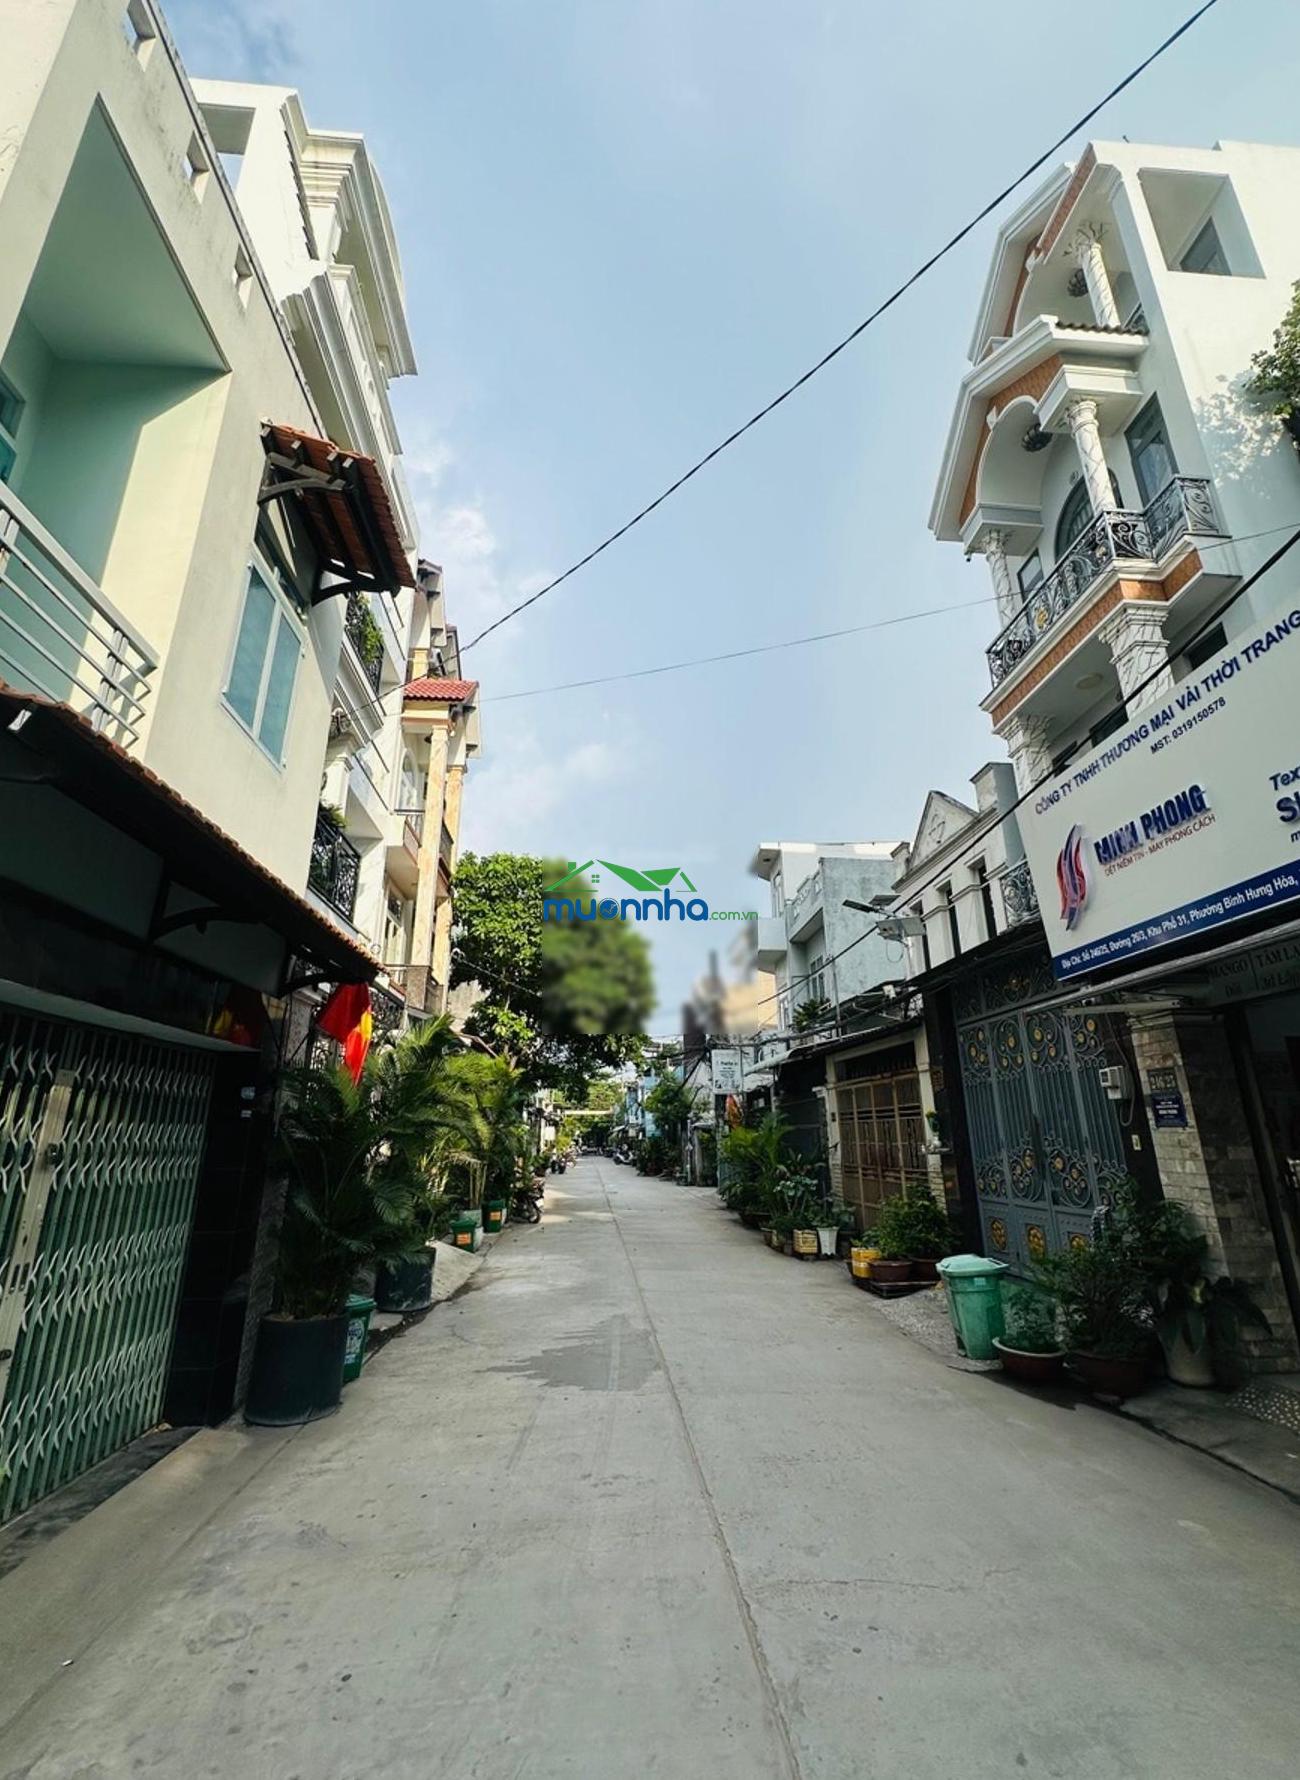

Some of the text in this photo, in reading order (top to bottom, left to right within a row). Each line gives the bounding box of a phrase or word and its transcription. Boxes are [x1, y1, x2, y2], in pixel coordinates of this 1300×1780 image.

[1035, 790, 1061, 814] CÔNG
[1060, 779, 1072, 797] TY
[1072, 759, 1101, 787] TNHH
[1099, 724, 1149, 768] THƯƠNG
[1150, 705, 1175, 732] MẠI
[1201, 656, 1241, 692] THỜI
[1240, 610, 1300, 663] TRANG
[1150, 696, 1226, 754] MST: 0319150578
[1140, 784, 1208, 840] PHONG
[1165, 825, 1193, 846] PHONG
[1245, 883, 1274, 901] Hưng
